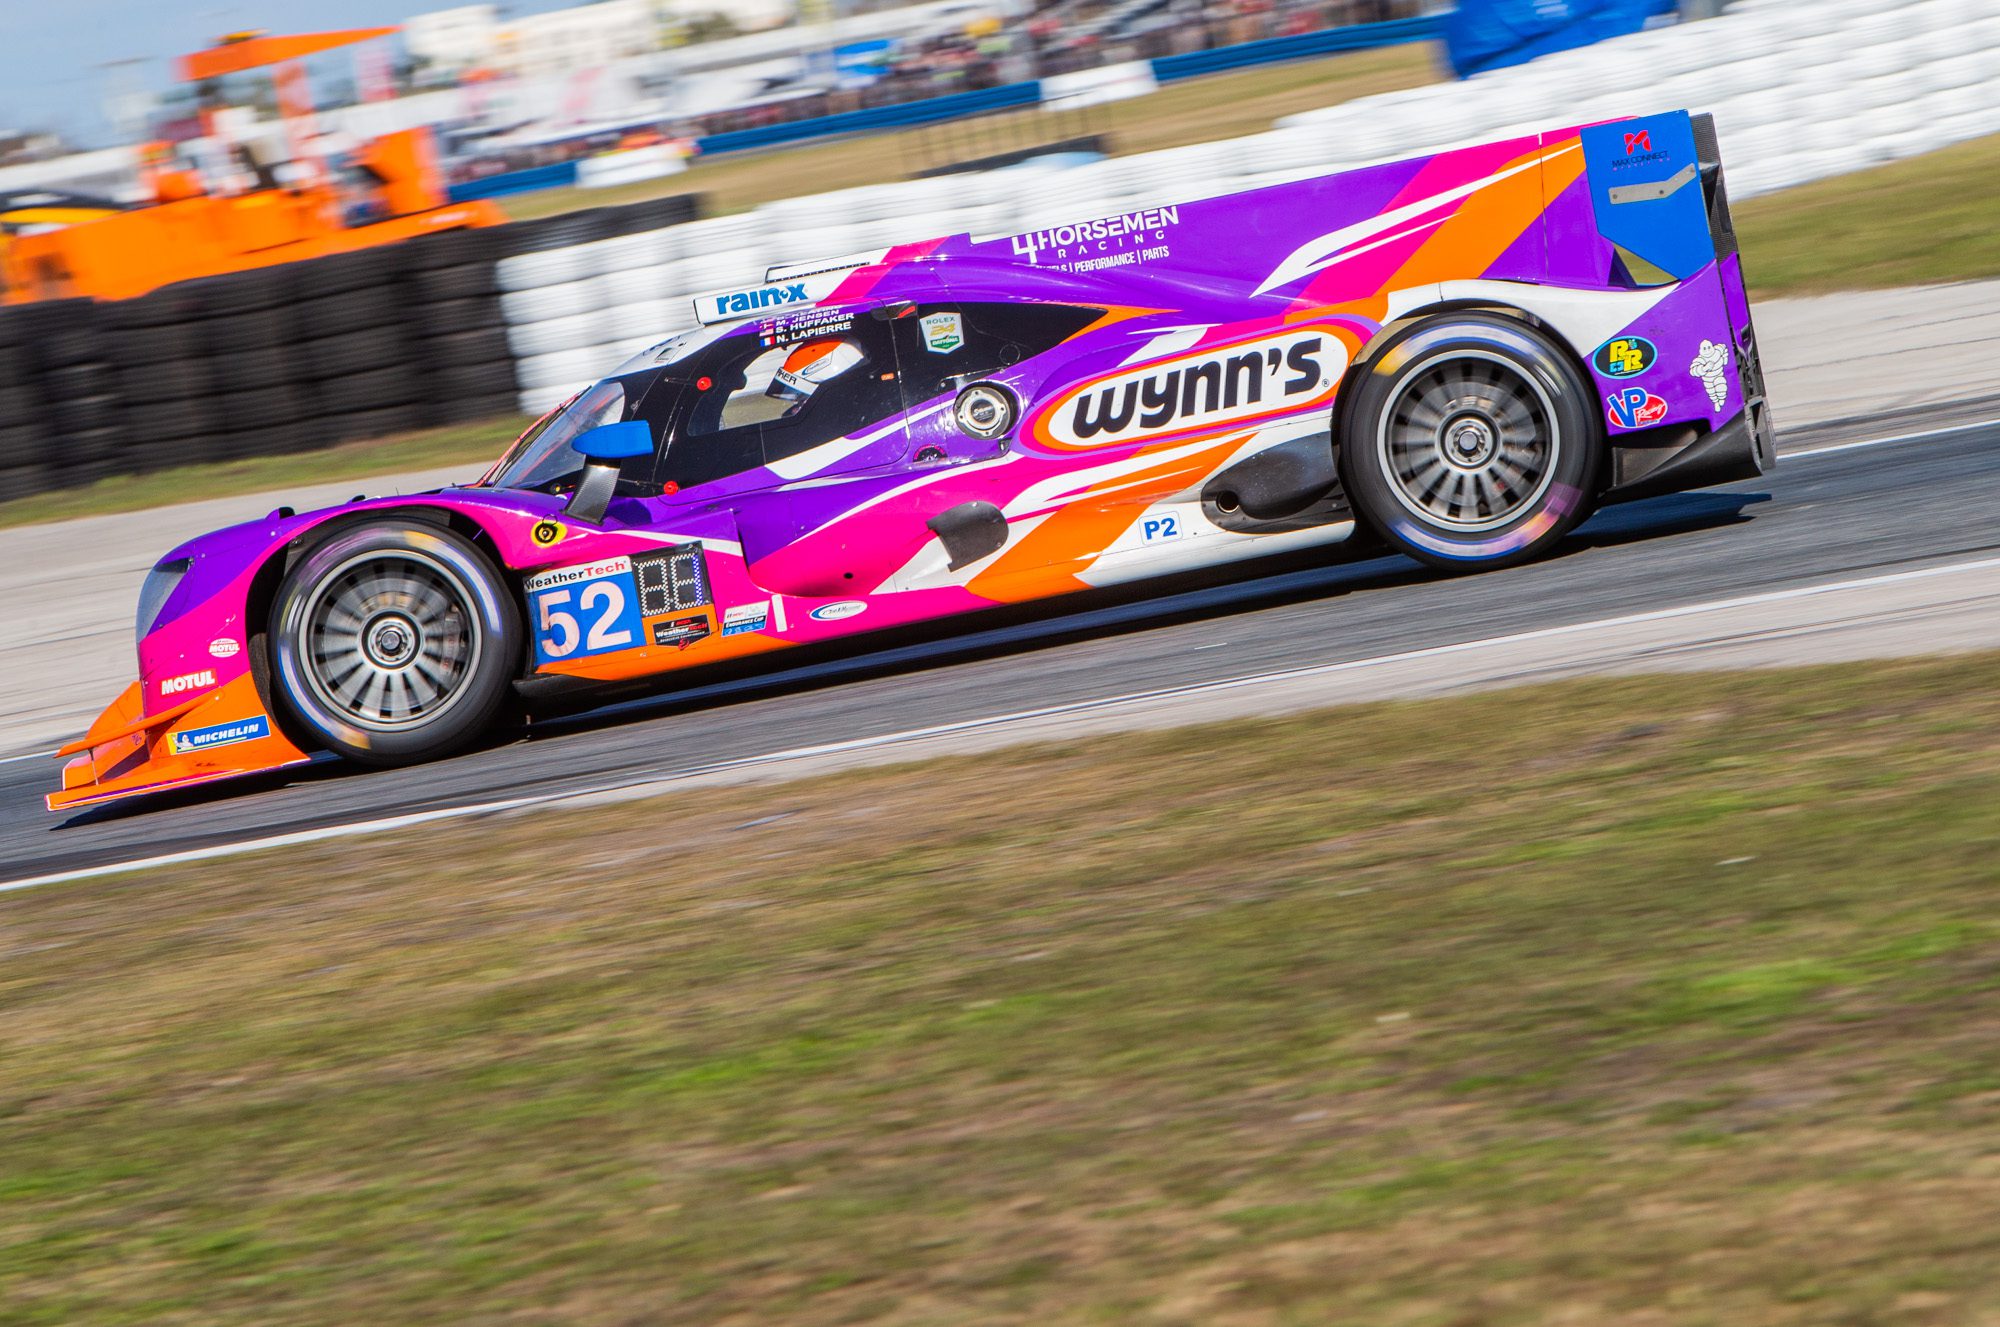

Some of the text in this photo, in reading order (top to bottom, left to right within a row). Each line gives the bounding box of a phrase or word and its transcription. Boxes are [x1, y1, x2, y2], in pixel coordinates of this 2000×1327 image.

[1612, 158, 1630, 168] MAX
[1058, 230, 1165, 258] RACING
[1074, 251, 1136, 273] PERFORMANCE
[1143, 245, 1170, 260] PARTS
[775, 312, 855, 334] S. HUFFAKER
[792, 309, 840, 324] JENSEN
[926, 316, 955, 325] ROLEX
[776, 321, 851, 343] N. LAPIERRE
[1607, 387, 1648, 428] VP
[1143, 517, 1178, 540] P2
[525, 561, 626, 590] WeatherTech
[538, 581, 632, 657] 52
[209, 642, 240, 654] MOTUL
[161, 670, 215, 695] MOTUL
[193, 723, 259, 745] MICHELIN
